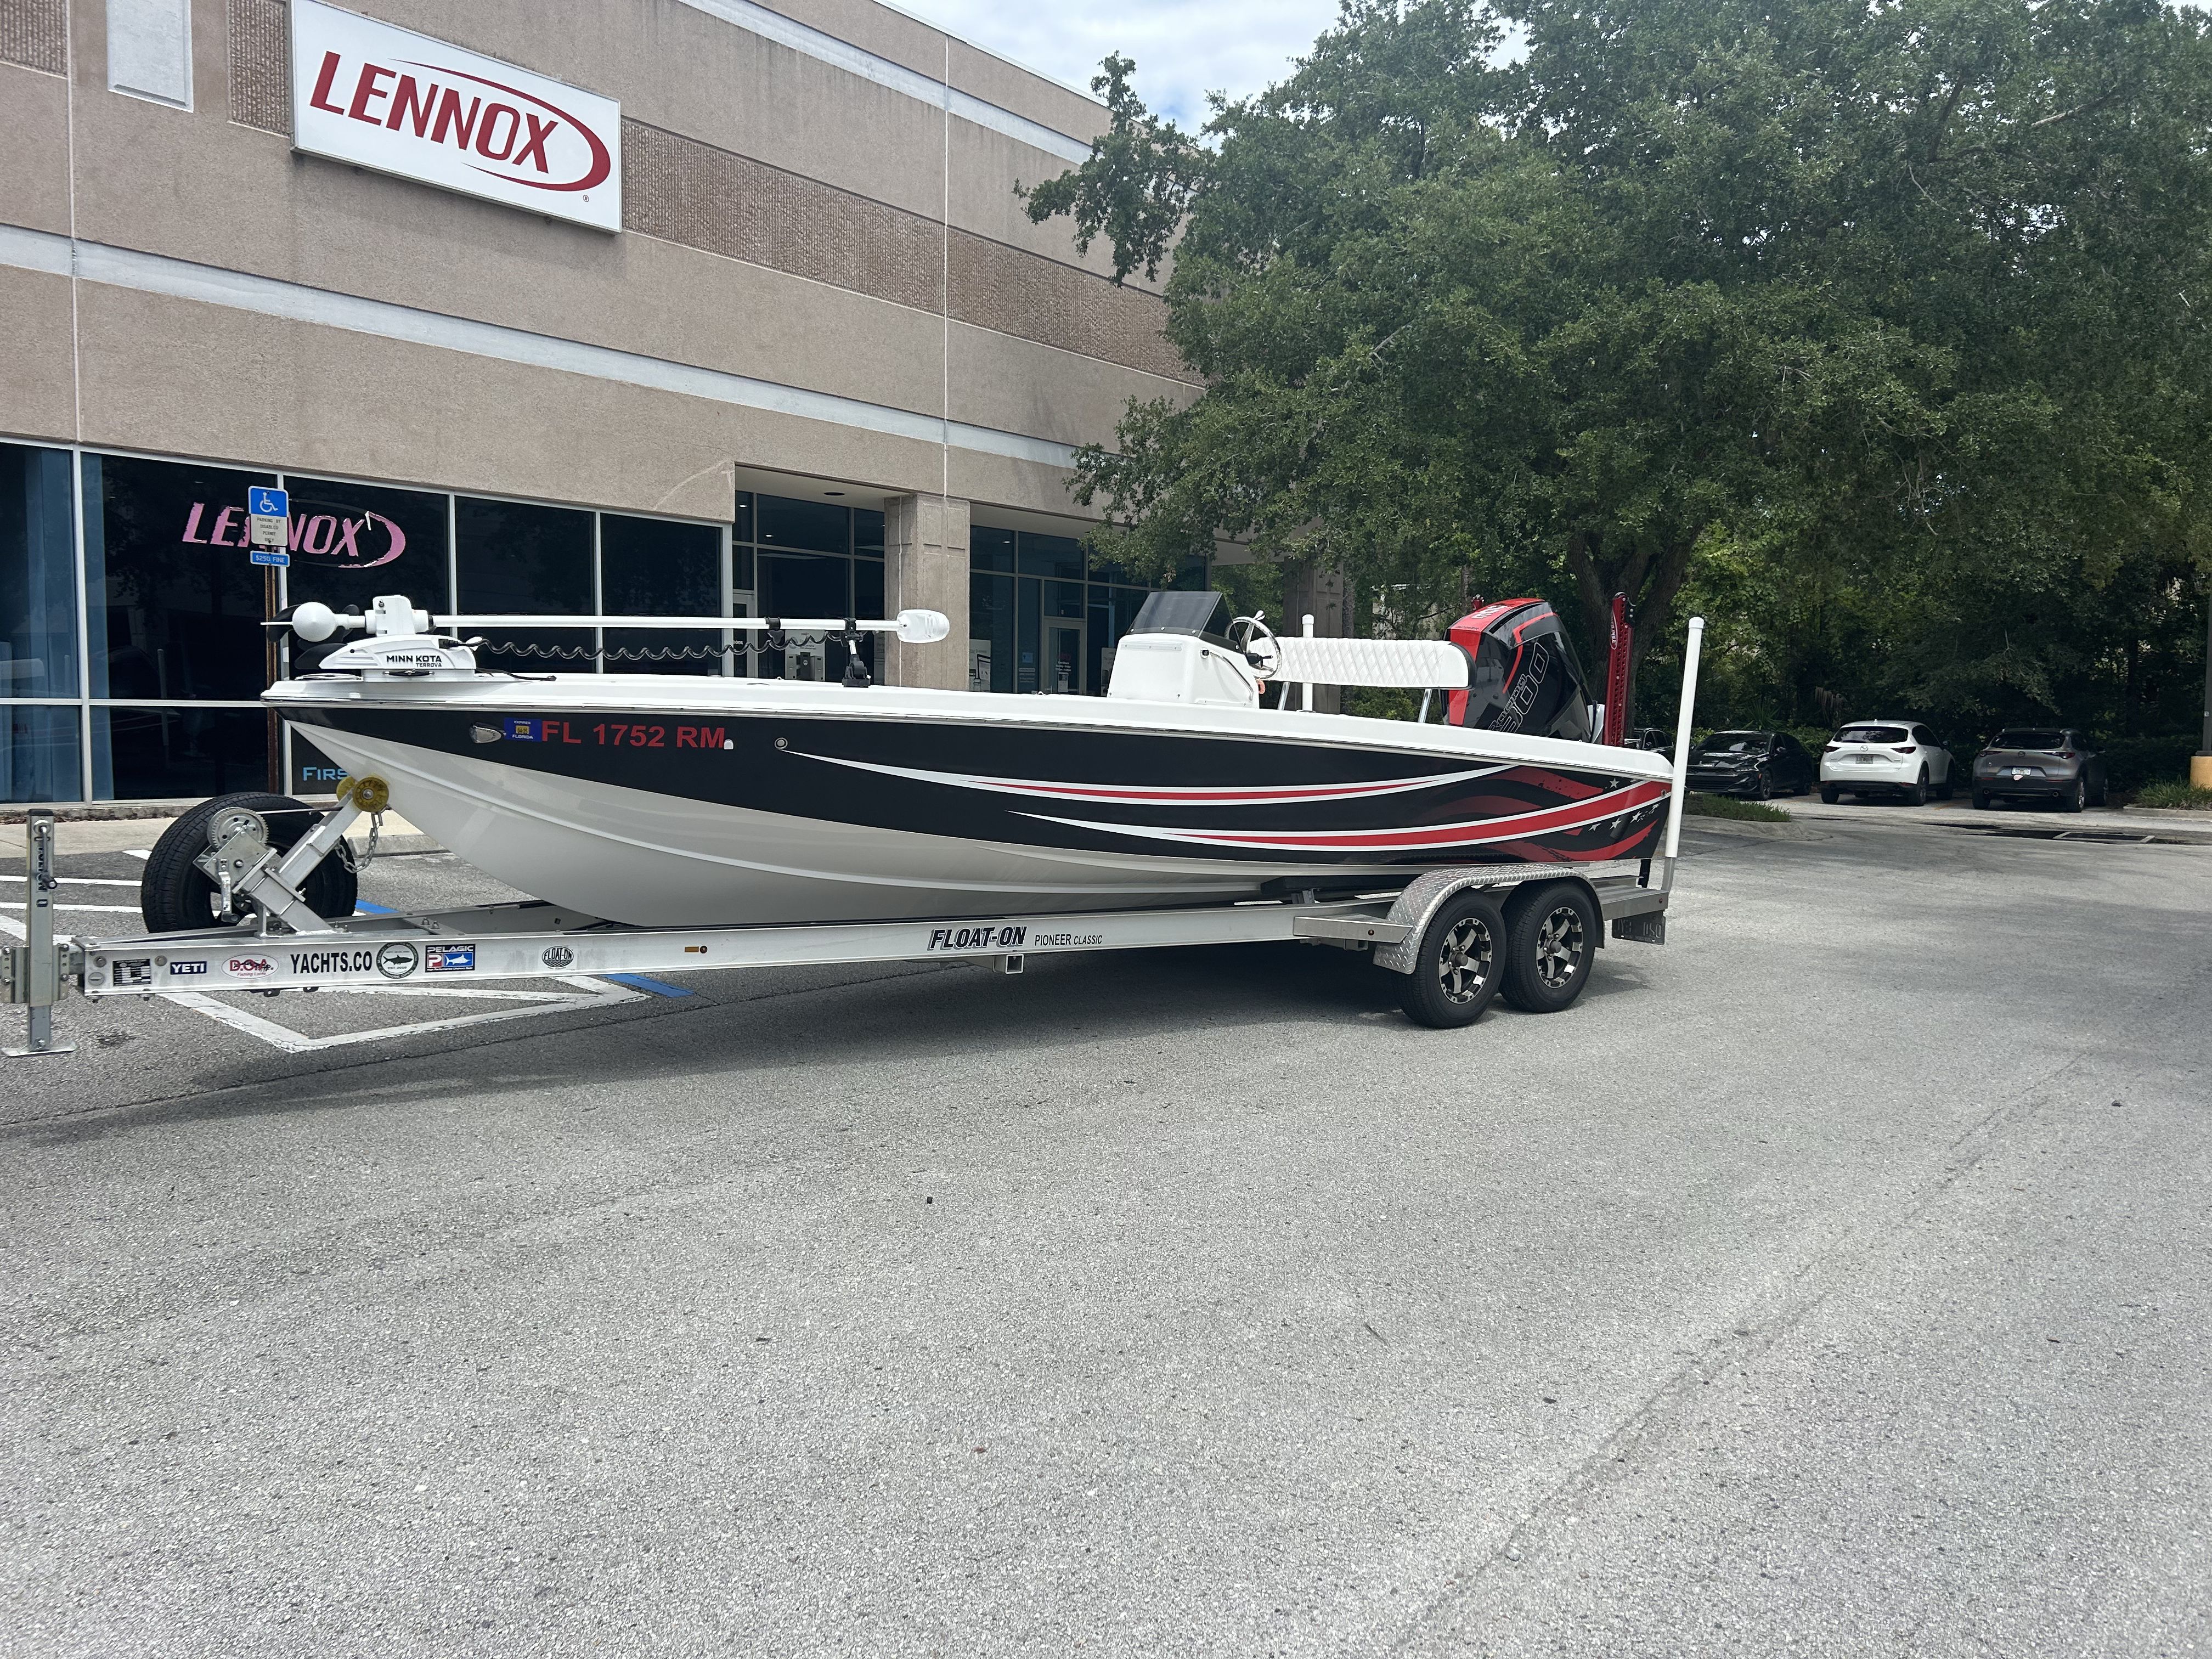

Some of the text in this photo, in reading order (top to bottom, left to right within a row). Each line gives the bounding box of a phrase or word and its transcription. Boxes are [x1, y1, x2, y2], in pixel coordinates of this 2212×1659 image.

[309, 50, 558, 174] LENNOX
[542, 720, 725, 748] FL 1752 RM
[927, 926, 1103, 951] FLOAT-ON PIONEER CLASSIC
[290, 951, 372, 974] YACHTS.CO
[544, 947, 572, 960] FLOAT-ON
[172, 963, 205, 973] YETI
